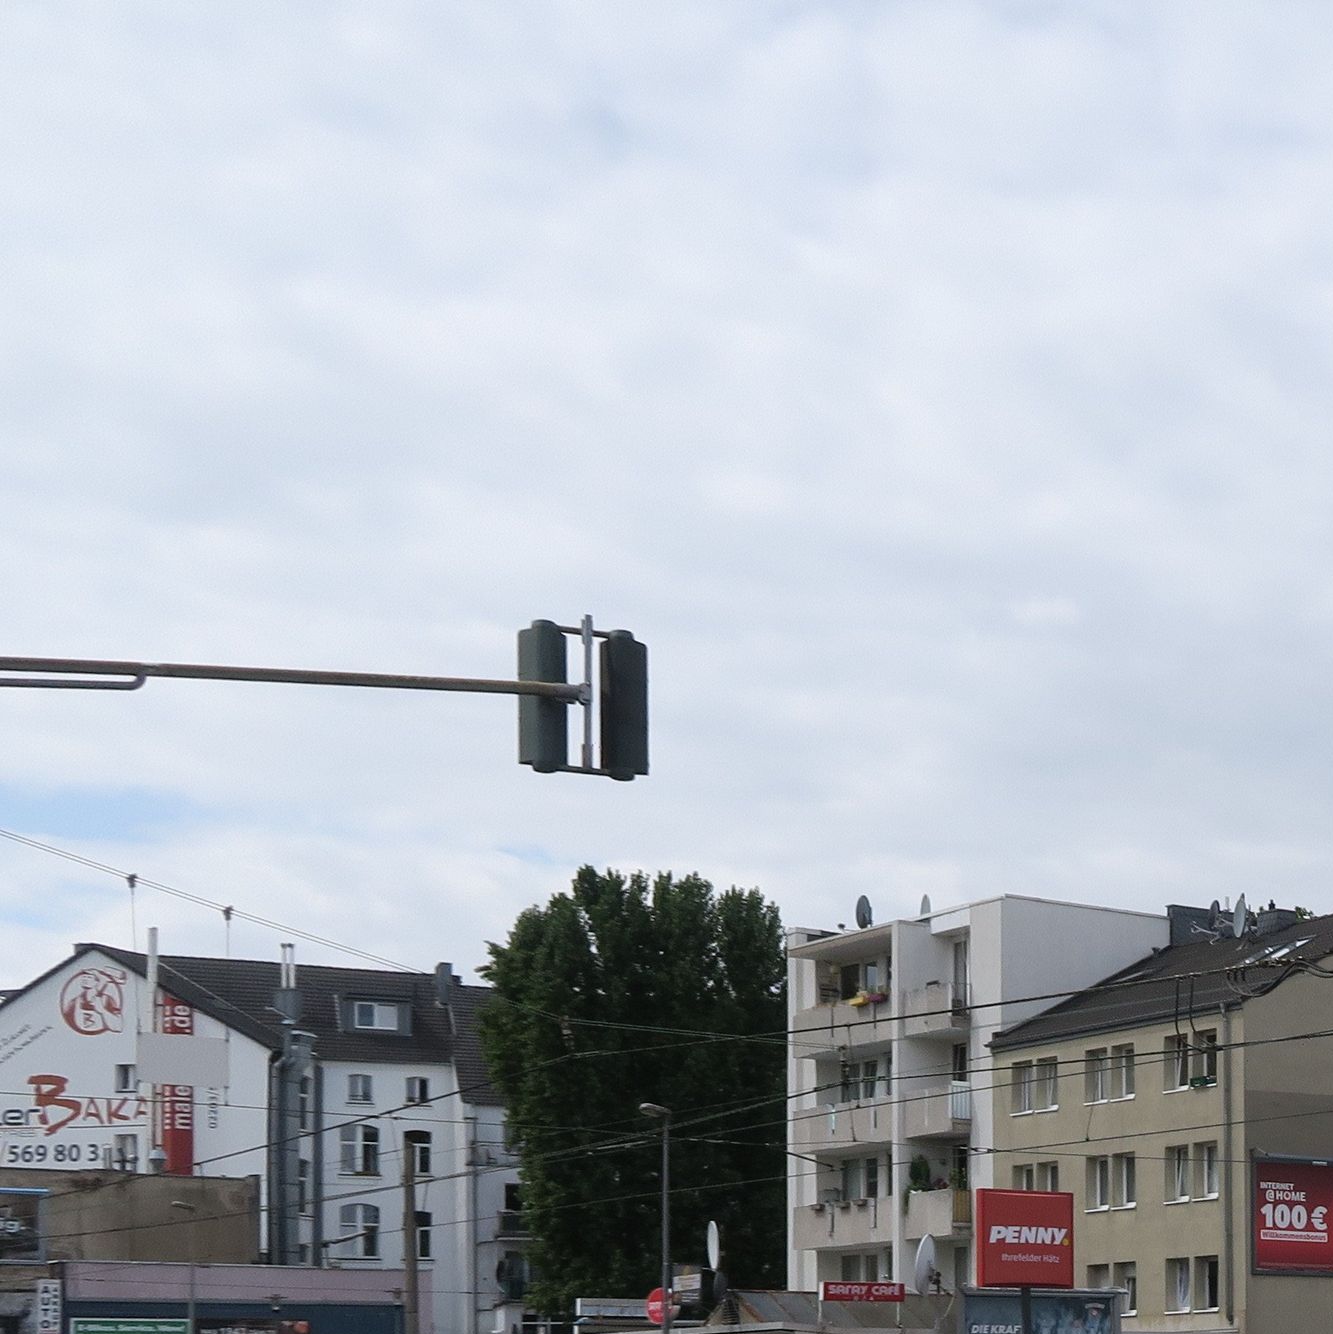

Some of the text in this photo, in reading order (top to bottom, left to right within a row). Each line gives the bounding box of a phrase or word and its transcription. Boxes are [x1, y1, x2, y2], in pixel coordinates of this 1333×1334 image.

[53, 1143, 81, 1162] 80
[1260, 1181, 1294, 1191] INTERNET
[1260, 1203, 1328, 1231] 100 €
[1262, 1231, 1326, 1242] Willkommensbonus
[40, 1286, 50, 1330] AUTO
[971, 1325, 989, 1334] DIE
